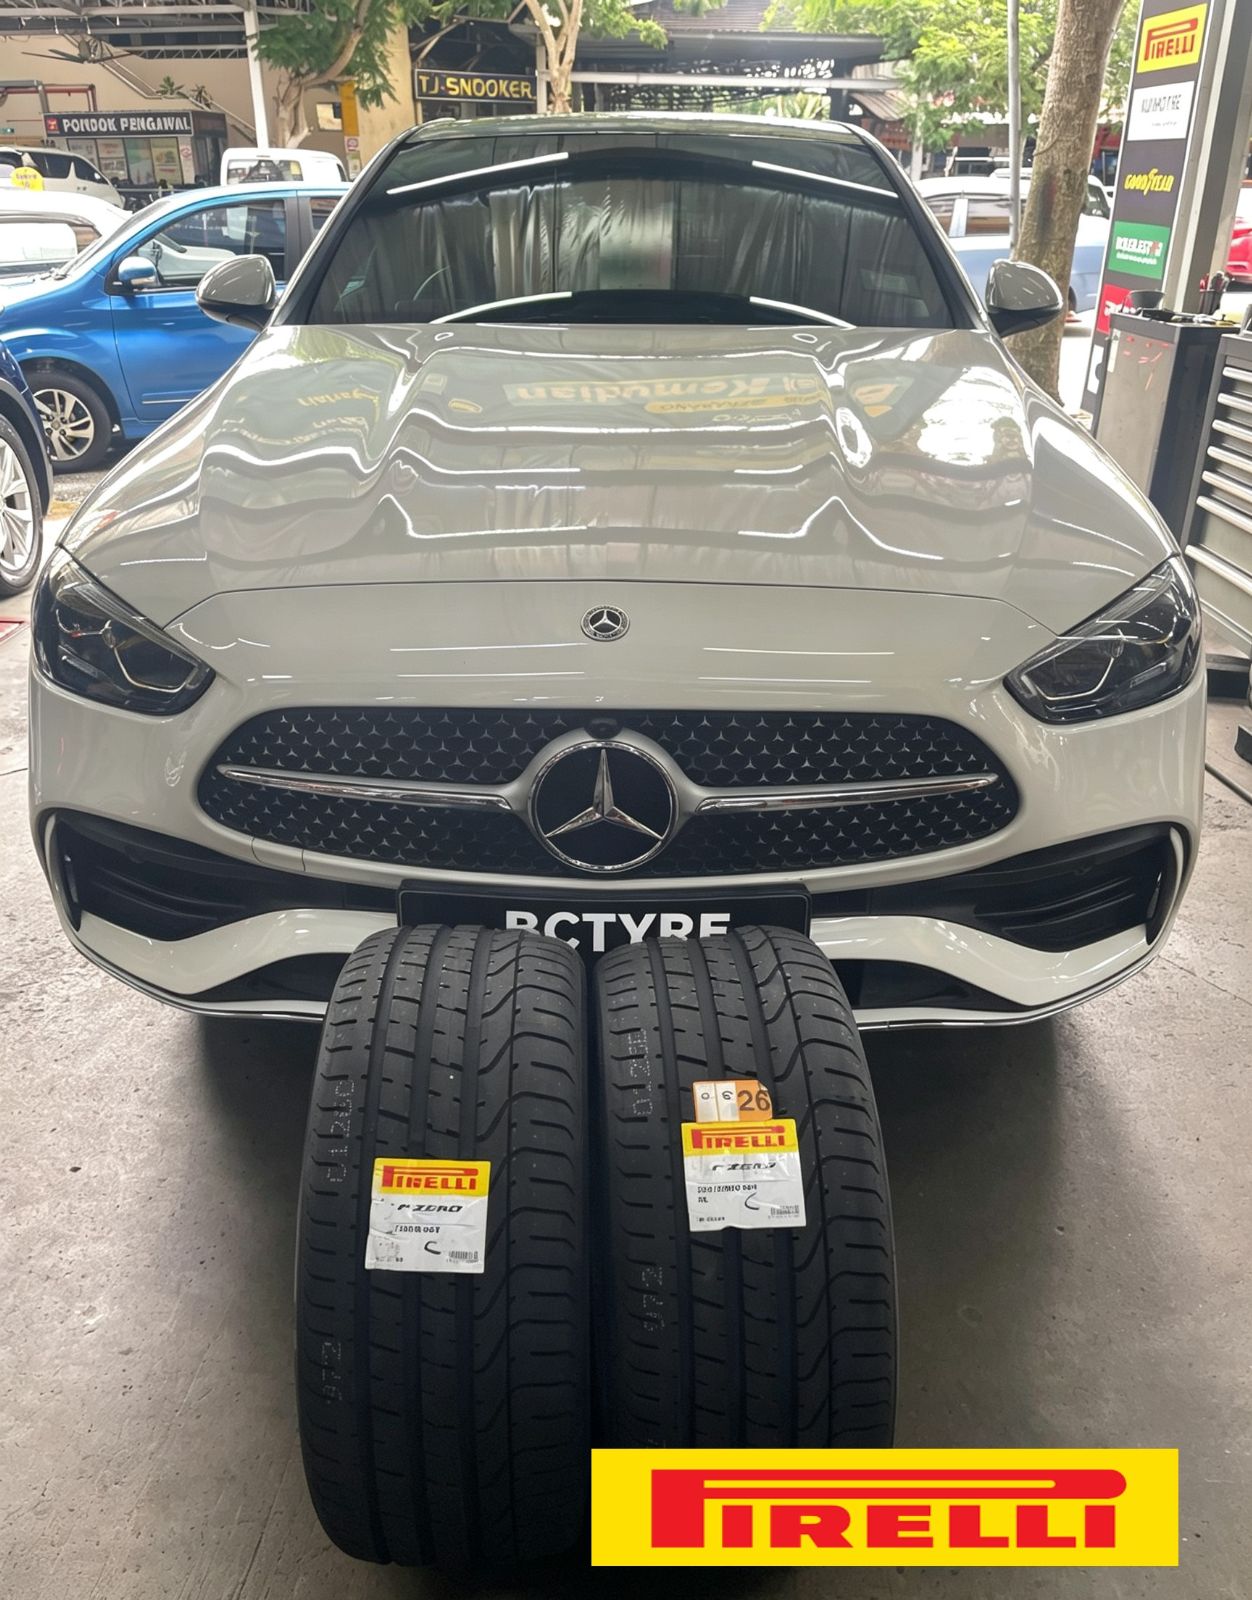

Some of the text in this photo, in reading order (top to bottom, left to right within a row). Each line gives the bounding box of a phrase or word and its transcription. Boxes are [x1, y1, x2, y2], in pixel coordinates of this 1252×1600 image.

[1144, 17, 1199, 61] PIRELLI
[418, 75, 533, 98] TJ SNOOKER
[62, 117, 191, 133] PONDOK PENGAWAL
[737, 1089, 771, 1112] 26
[691, 1125, 785, 1149] PIRELLI
[381, 1166, 479, 1190] PIRELLI
